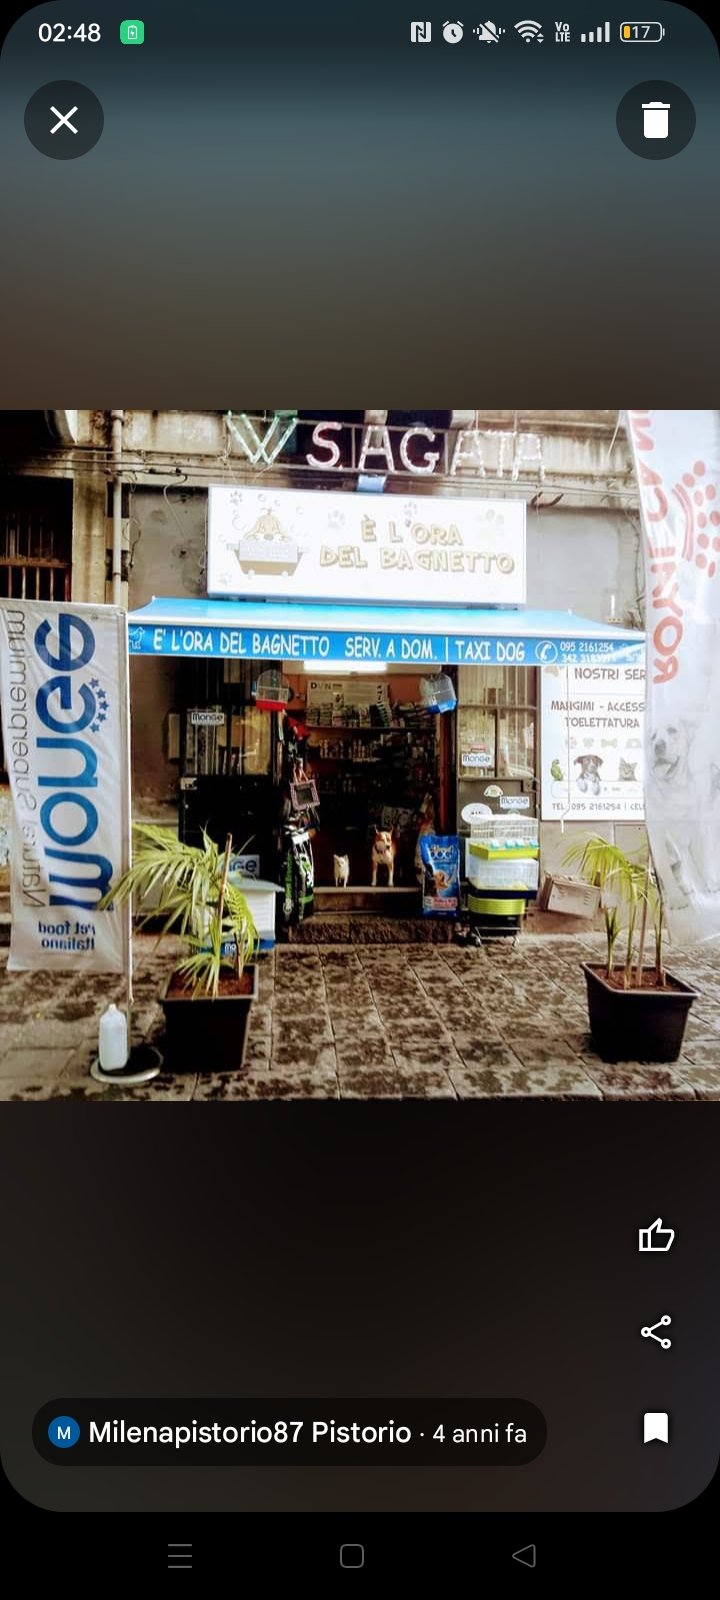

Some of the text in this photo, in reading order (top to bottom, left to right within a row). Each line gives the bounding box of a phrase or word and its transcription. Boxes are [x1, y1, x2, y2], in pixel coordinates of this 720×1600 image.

[361, 514, 463, 546] È L'ORA
[320, 545, 515, 574] DEL BAGNETTO
[153, 629, 437, 660] E' L'ORA DEL BAGNETTO SERV. A DOM.
[456, 640, 526, 661] TAXI DOG
[560, 641, 615, 653] 095 2161254
[574, 667, 619, 680] NOSTRI
[551, 700, 594, 711] MANGIMI
[564, 717, 640, 728] TOELETTATURA
